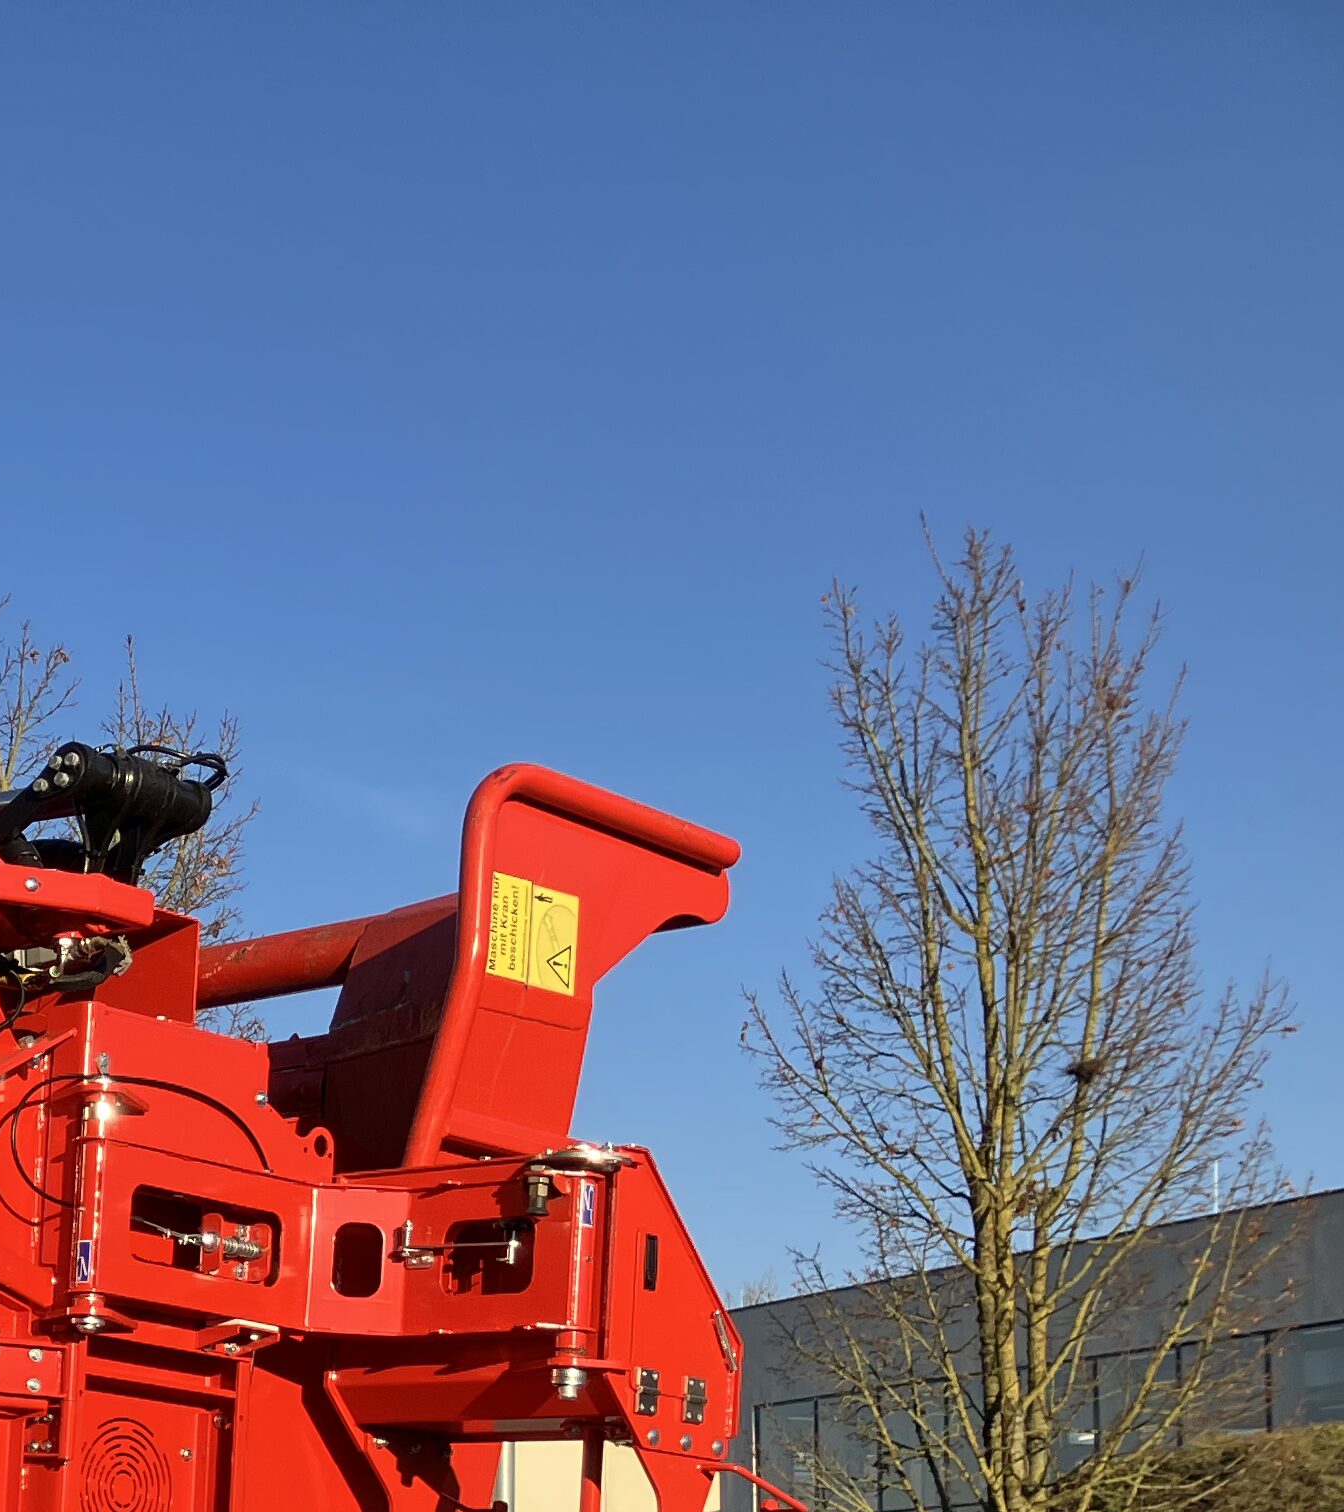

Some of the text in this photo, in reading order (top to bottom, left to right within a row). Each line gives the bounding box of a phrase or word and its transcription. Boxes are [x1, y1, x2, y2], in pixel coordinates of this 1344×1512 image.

[488, 875, 501, 971] Maschine nur
[499, 895, 509, 929] Kran
[508, 885, 520, 971] beschicken!
